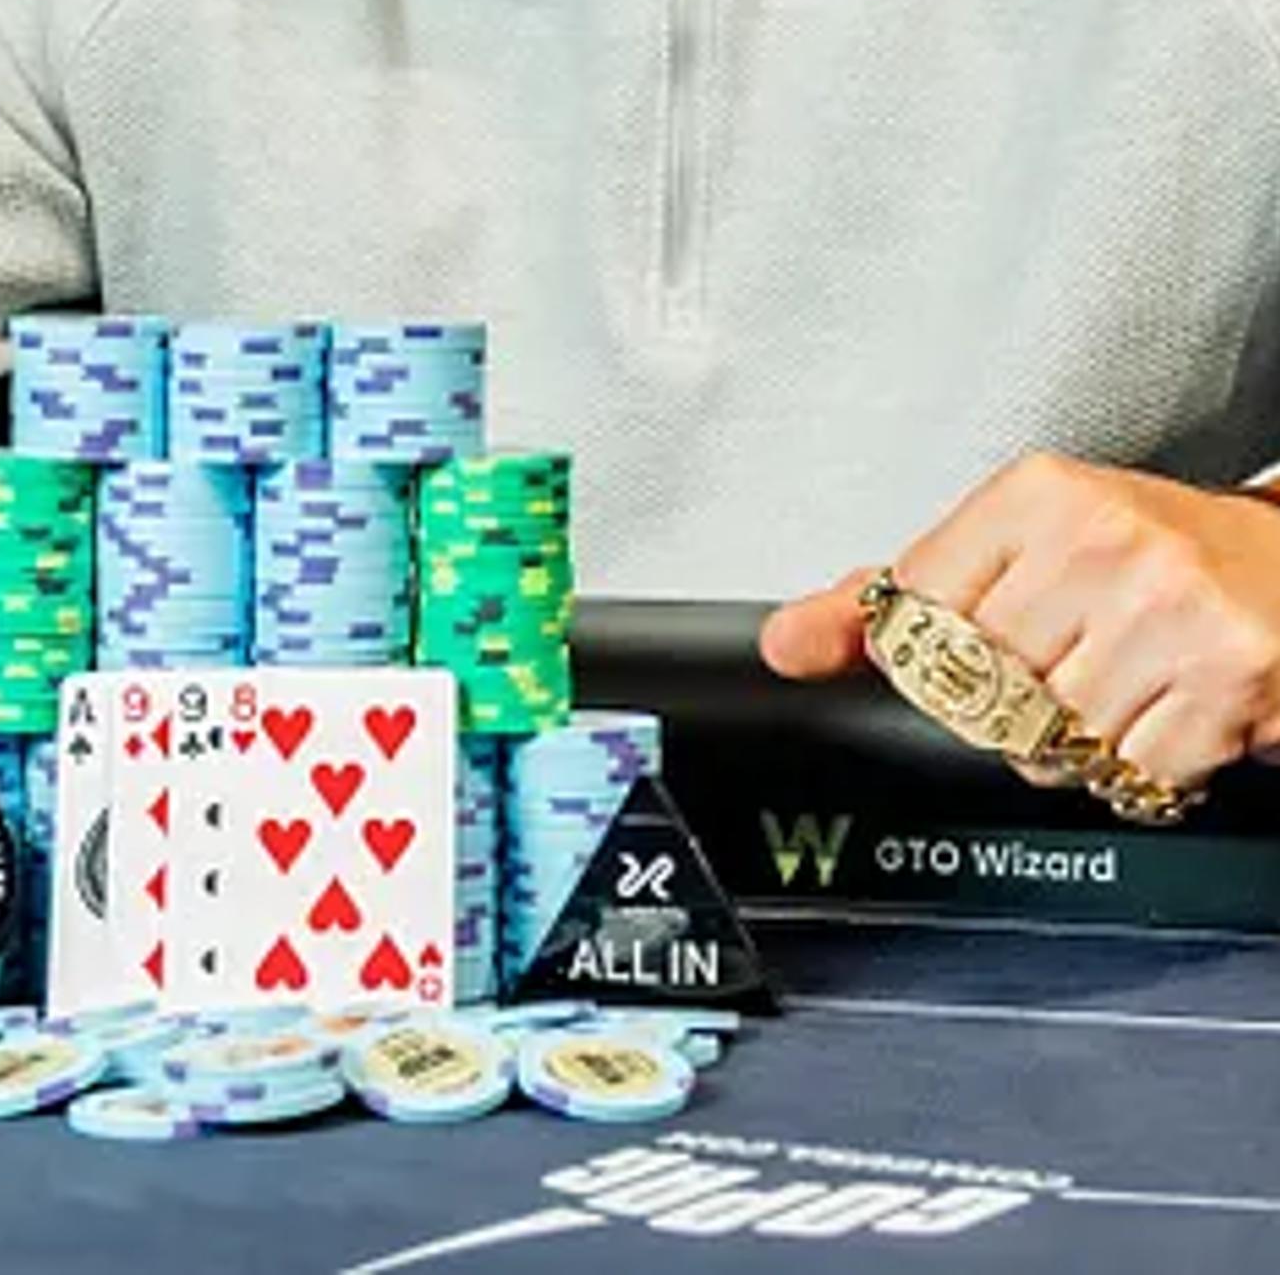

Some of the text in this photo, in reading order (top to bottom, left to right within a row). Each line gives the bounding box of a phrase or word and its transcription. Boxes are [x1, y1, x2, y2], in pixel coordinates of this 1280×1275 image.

[69, 688, 95, 723] A
[123, 686, 150, 722] 9
[179, 685, 208, 723] 9
[231, 684, 257, 722] 8
[876, 839, 961, 875] GTO
[970, 841, 1117, 882] Wizard
[567, 938, 719, 986] ALL IN
